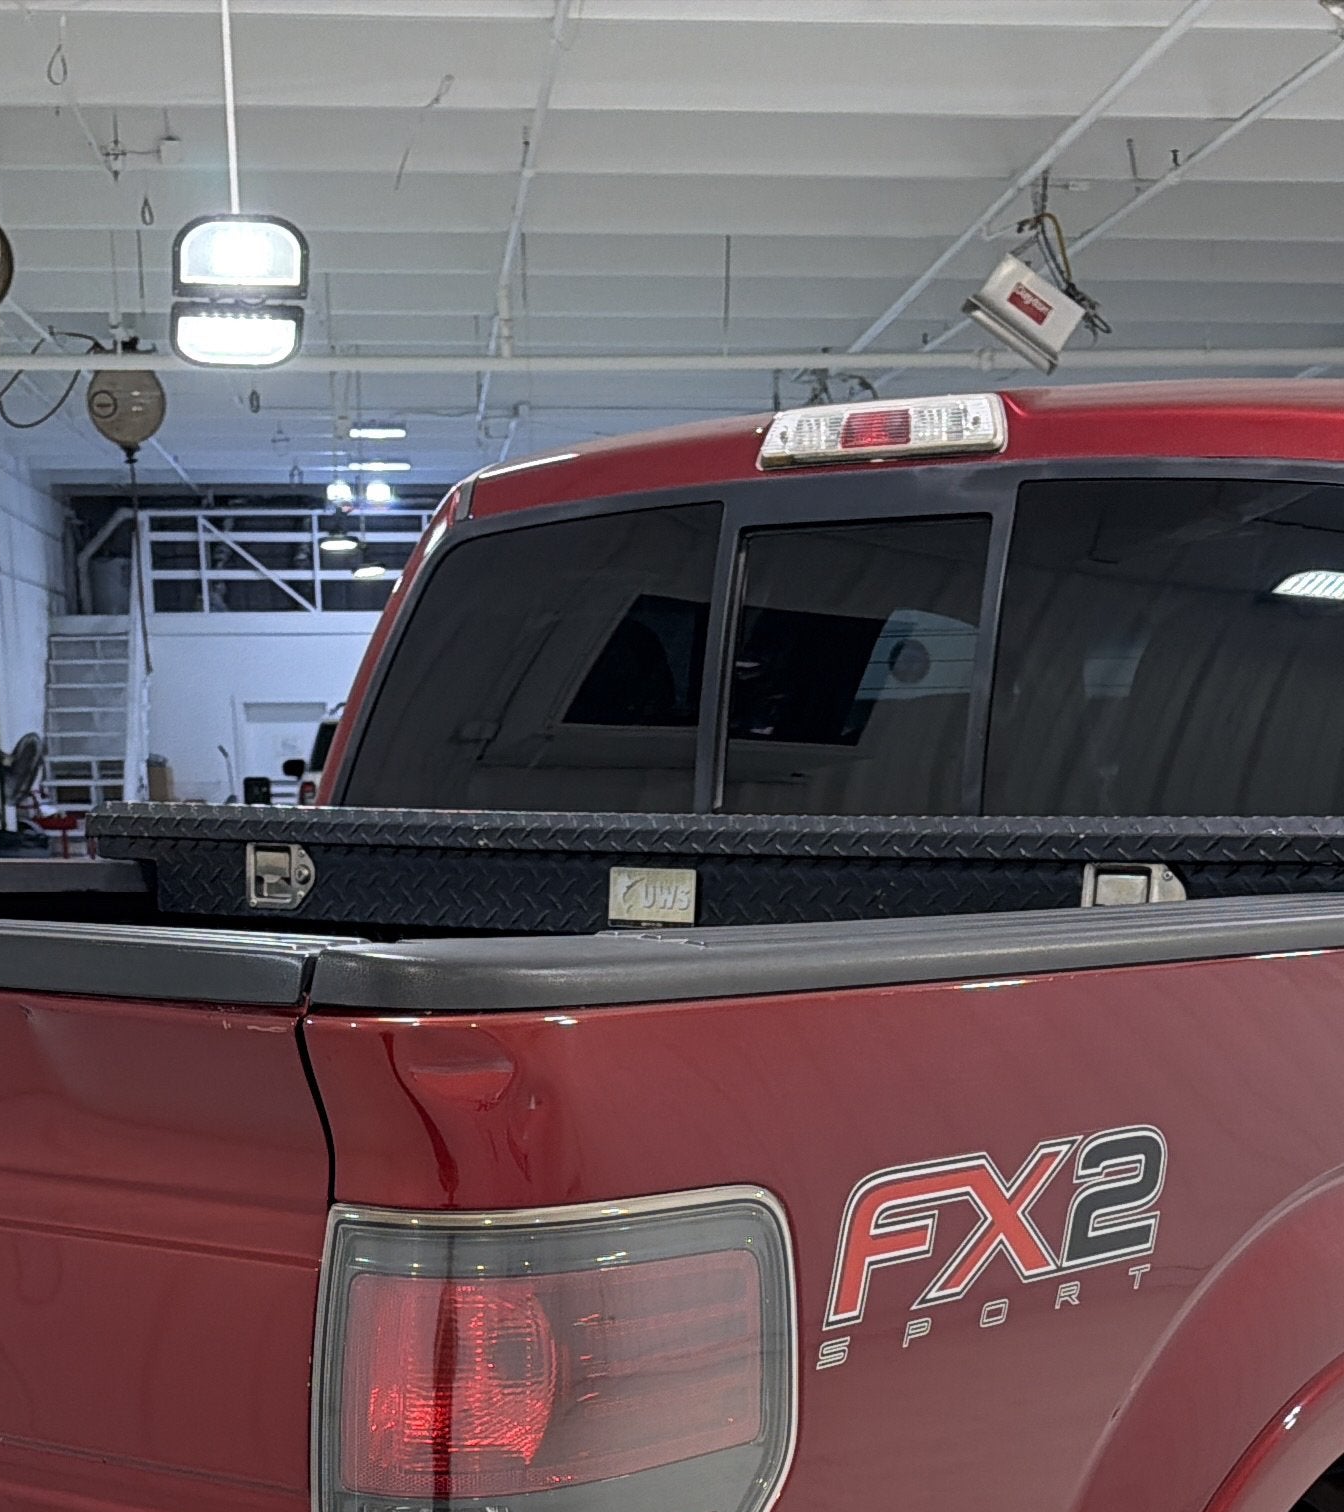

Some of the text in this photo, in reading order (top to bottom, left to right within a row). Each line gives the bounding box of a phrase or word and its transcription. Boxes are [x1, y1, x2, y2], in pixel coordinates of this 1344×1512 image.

[640, 884, 691, 911] UWS
[823, 1124, 1168, 1331] FX2
[816, 1264, 1150, 1370] SPORT
